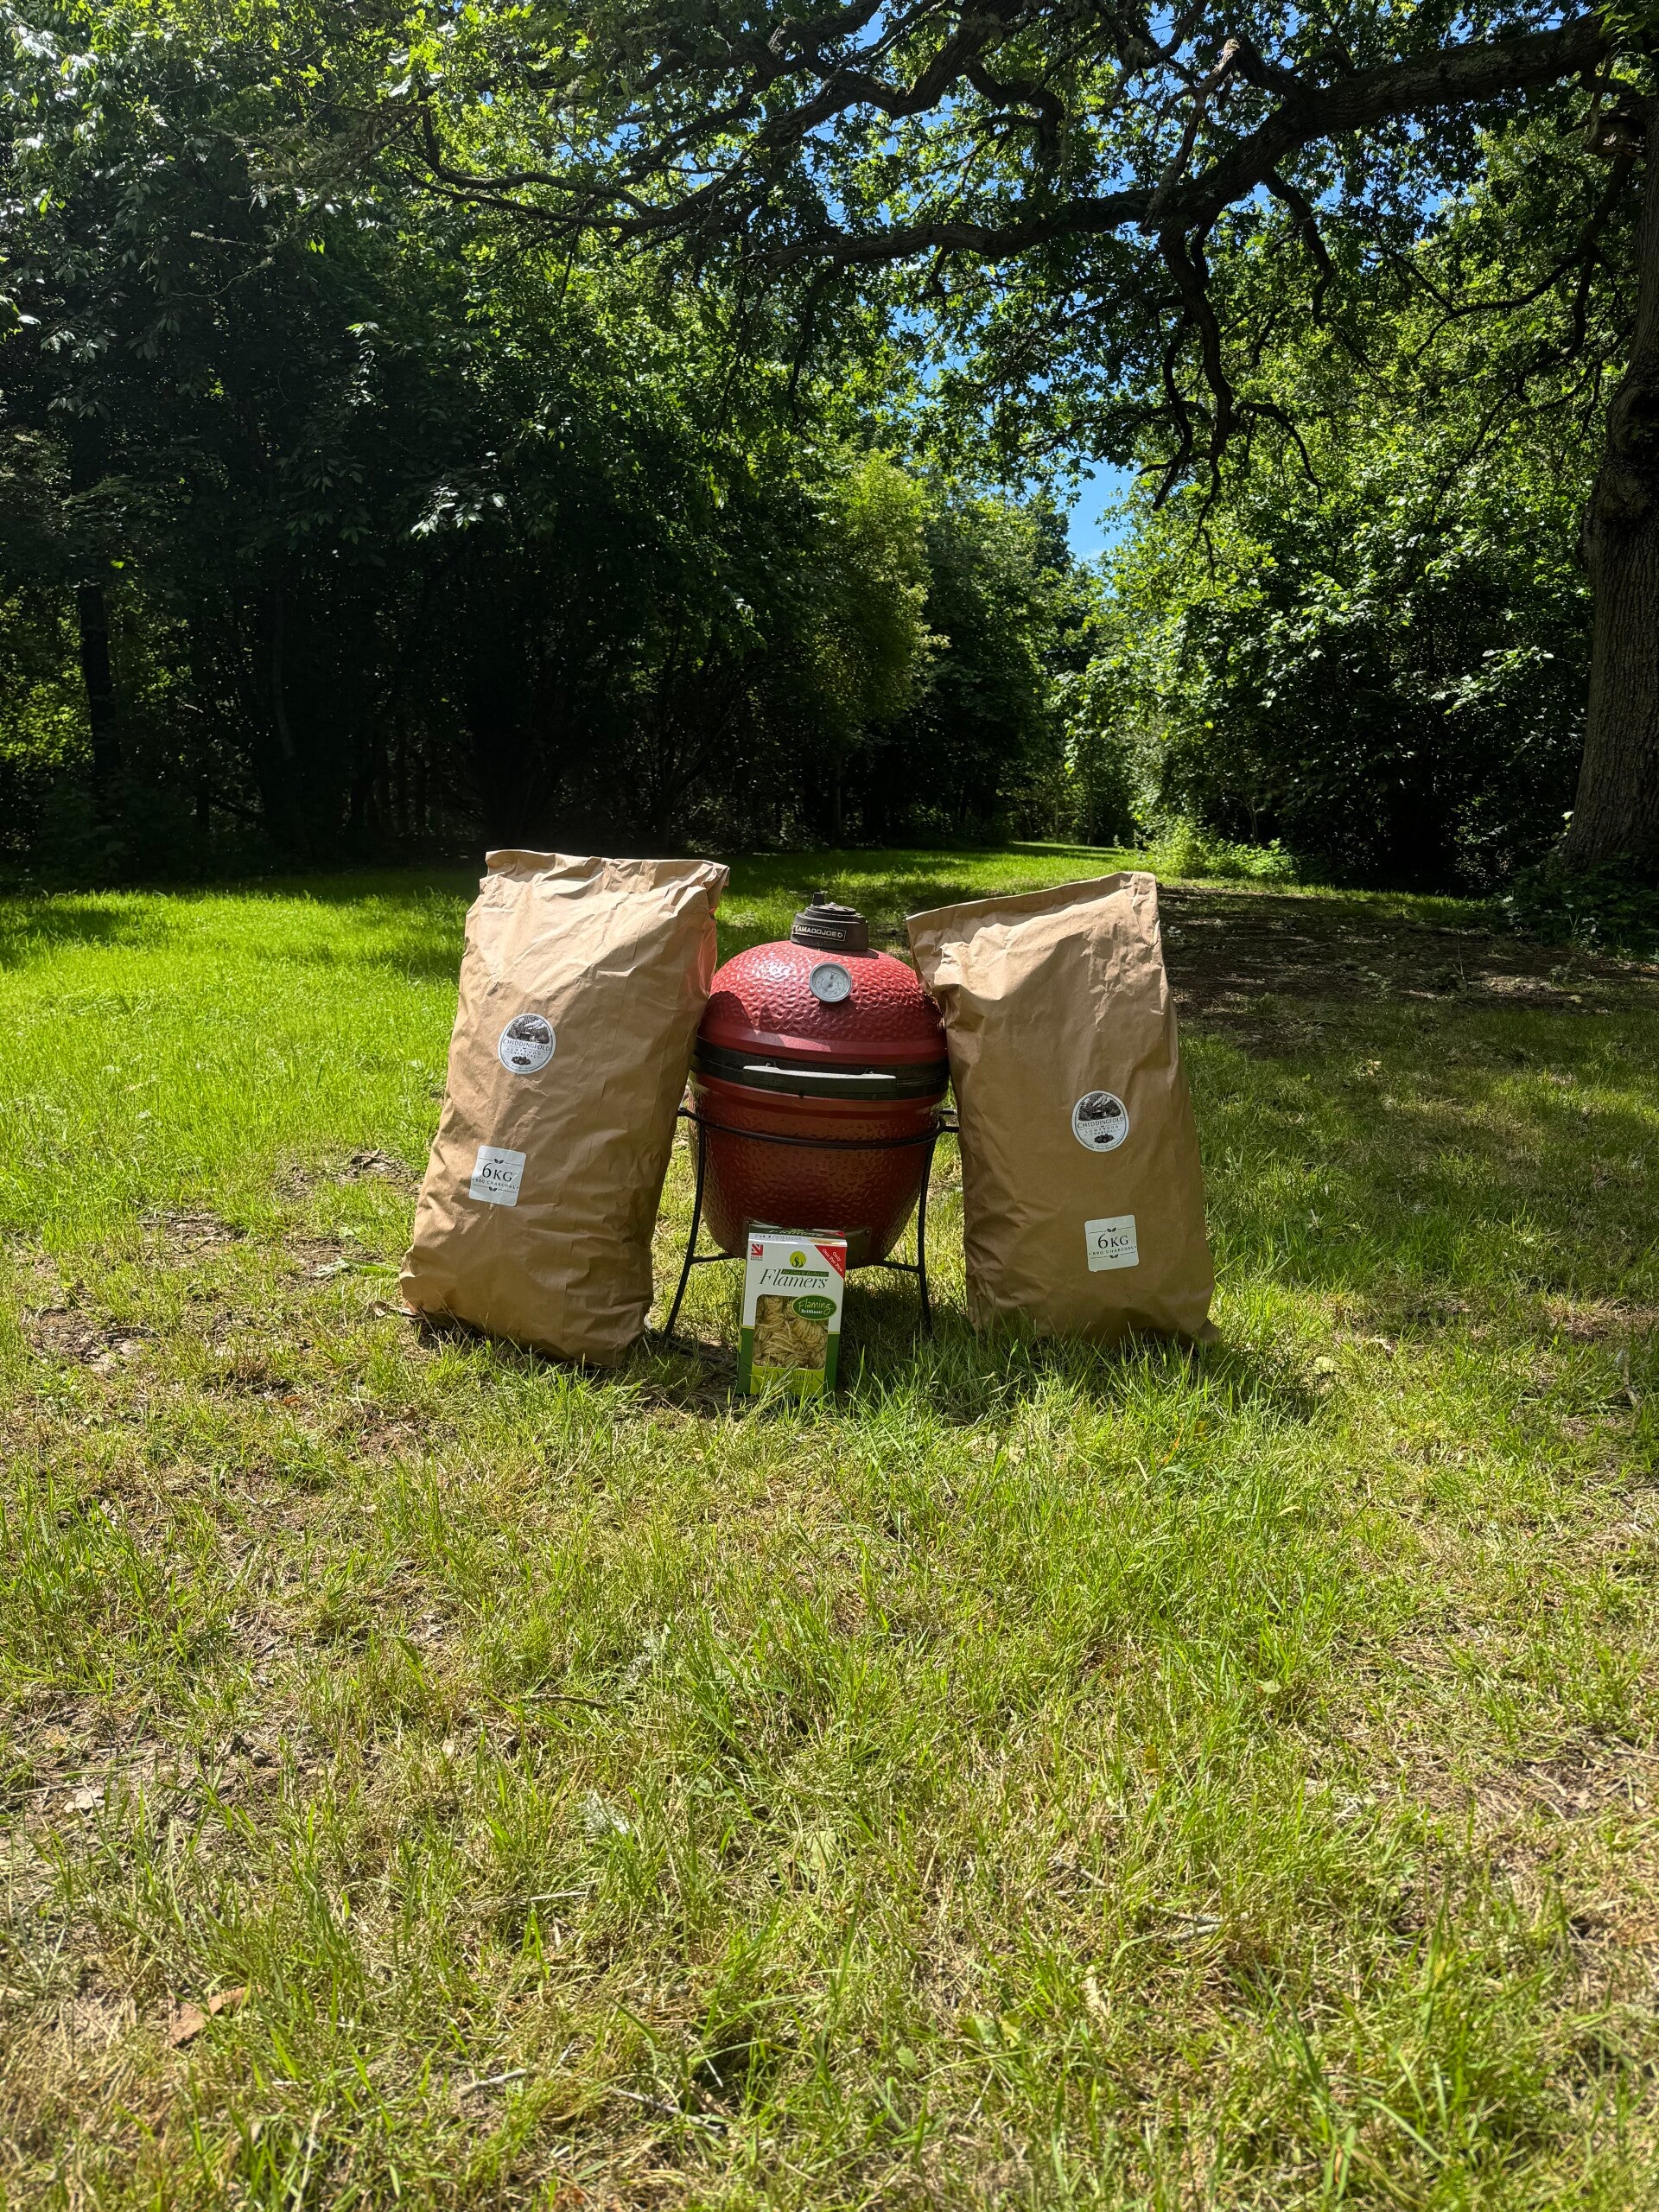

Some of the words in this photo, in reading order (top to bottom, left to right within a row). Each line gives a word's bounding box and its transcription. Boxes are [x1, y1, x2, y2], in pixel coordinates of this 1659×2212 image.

[502, 1038, 550, 1052] CHIDDINGFOLD
[1077, 1116, 1125, 1128] CHIDDINGFOLD
[481, 1162, 513, 1182] 6KG
[1097, 1233, 1128, 1249] 6KG
[759, 1268, 829, 1289] Flamers
[798, 1298, 833, 1315] Flaming
